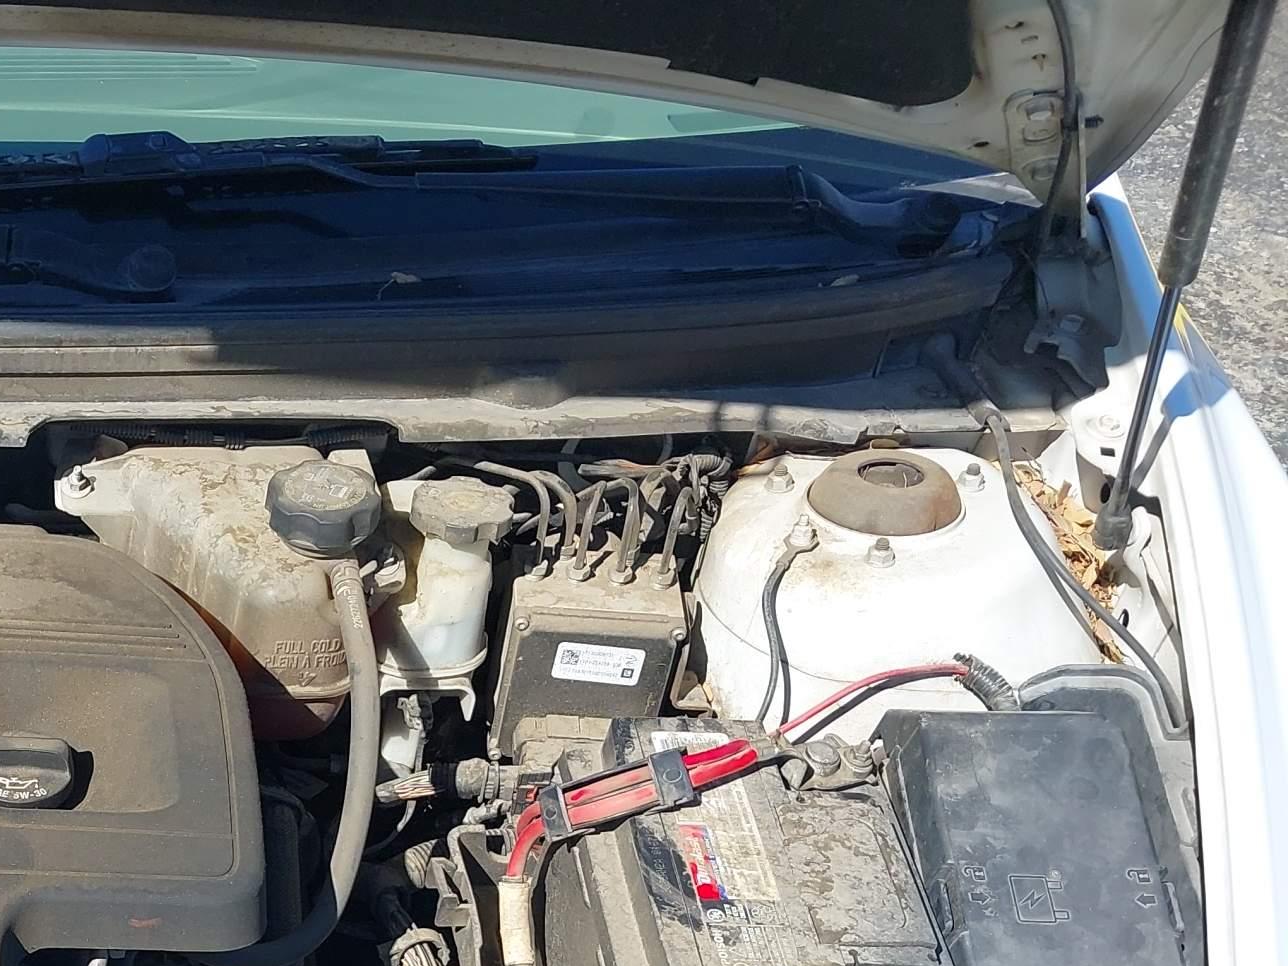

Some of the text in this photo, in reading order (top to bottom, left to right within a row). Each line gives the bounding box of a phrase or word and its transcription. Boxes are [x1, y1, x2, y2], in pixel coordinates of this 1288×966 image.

[274, 638, 342, 654] FULL COLD
[13, 788, 47, 800] 5W-30
